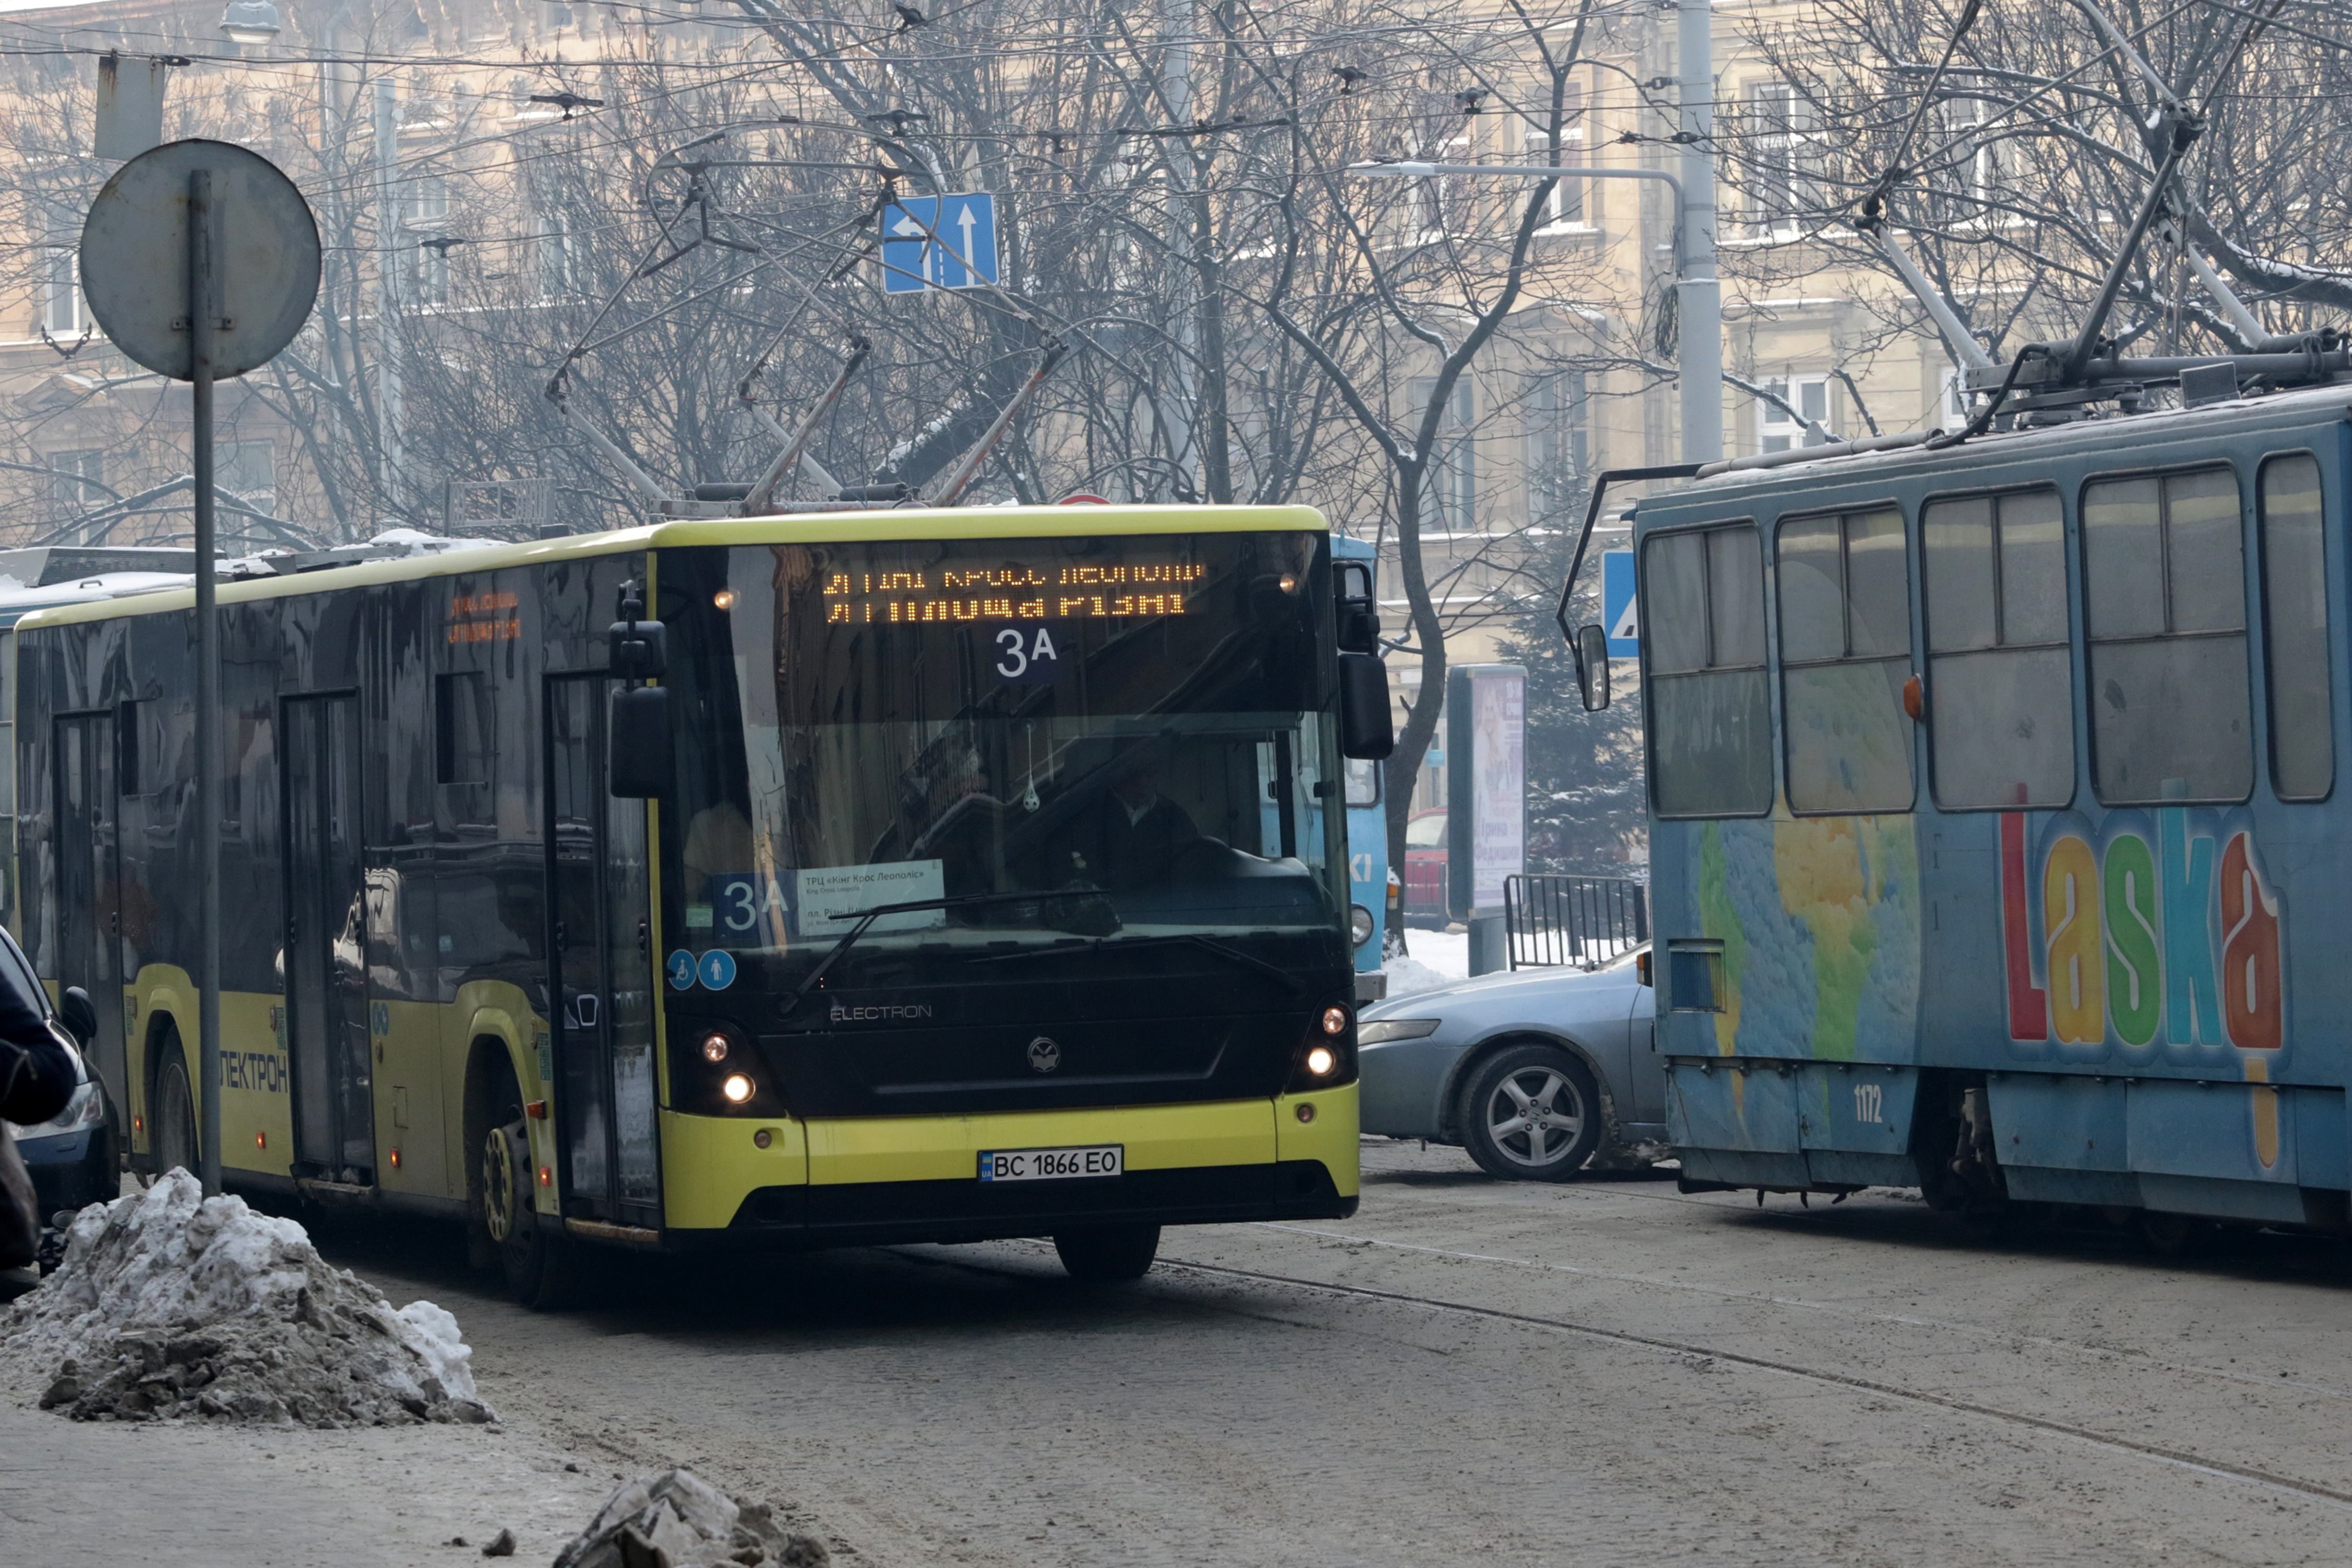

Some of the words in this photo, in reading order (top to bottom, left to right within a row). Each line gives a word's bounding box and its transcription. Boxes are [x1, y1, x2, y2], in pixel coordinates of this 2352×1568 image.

[996, 628, 1057, 677] 3A
[805, 877, 825, 886] ТРЦ
[853, 873, 875, 884] Крос
[724, 880, 789, 930] 3A
[831, 1006, 931, 1021] ELECTRON
[220, 1051, 288, 1093] ЛЕКТРОН
[1854, 1084, 1883, 1123] 1172
[994, 1156, 1025, 1177] BC
[1033, 1153, 1079, 1175] 1866
[1086, 1151, 1116, 1173] EO
